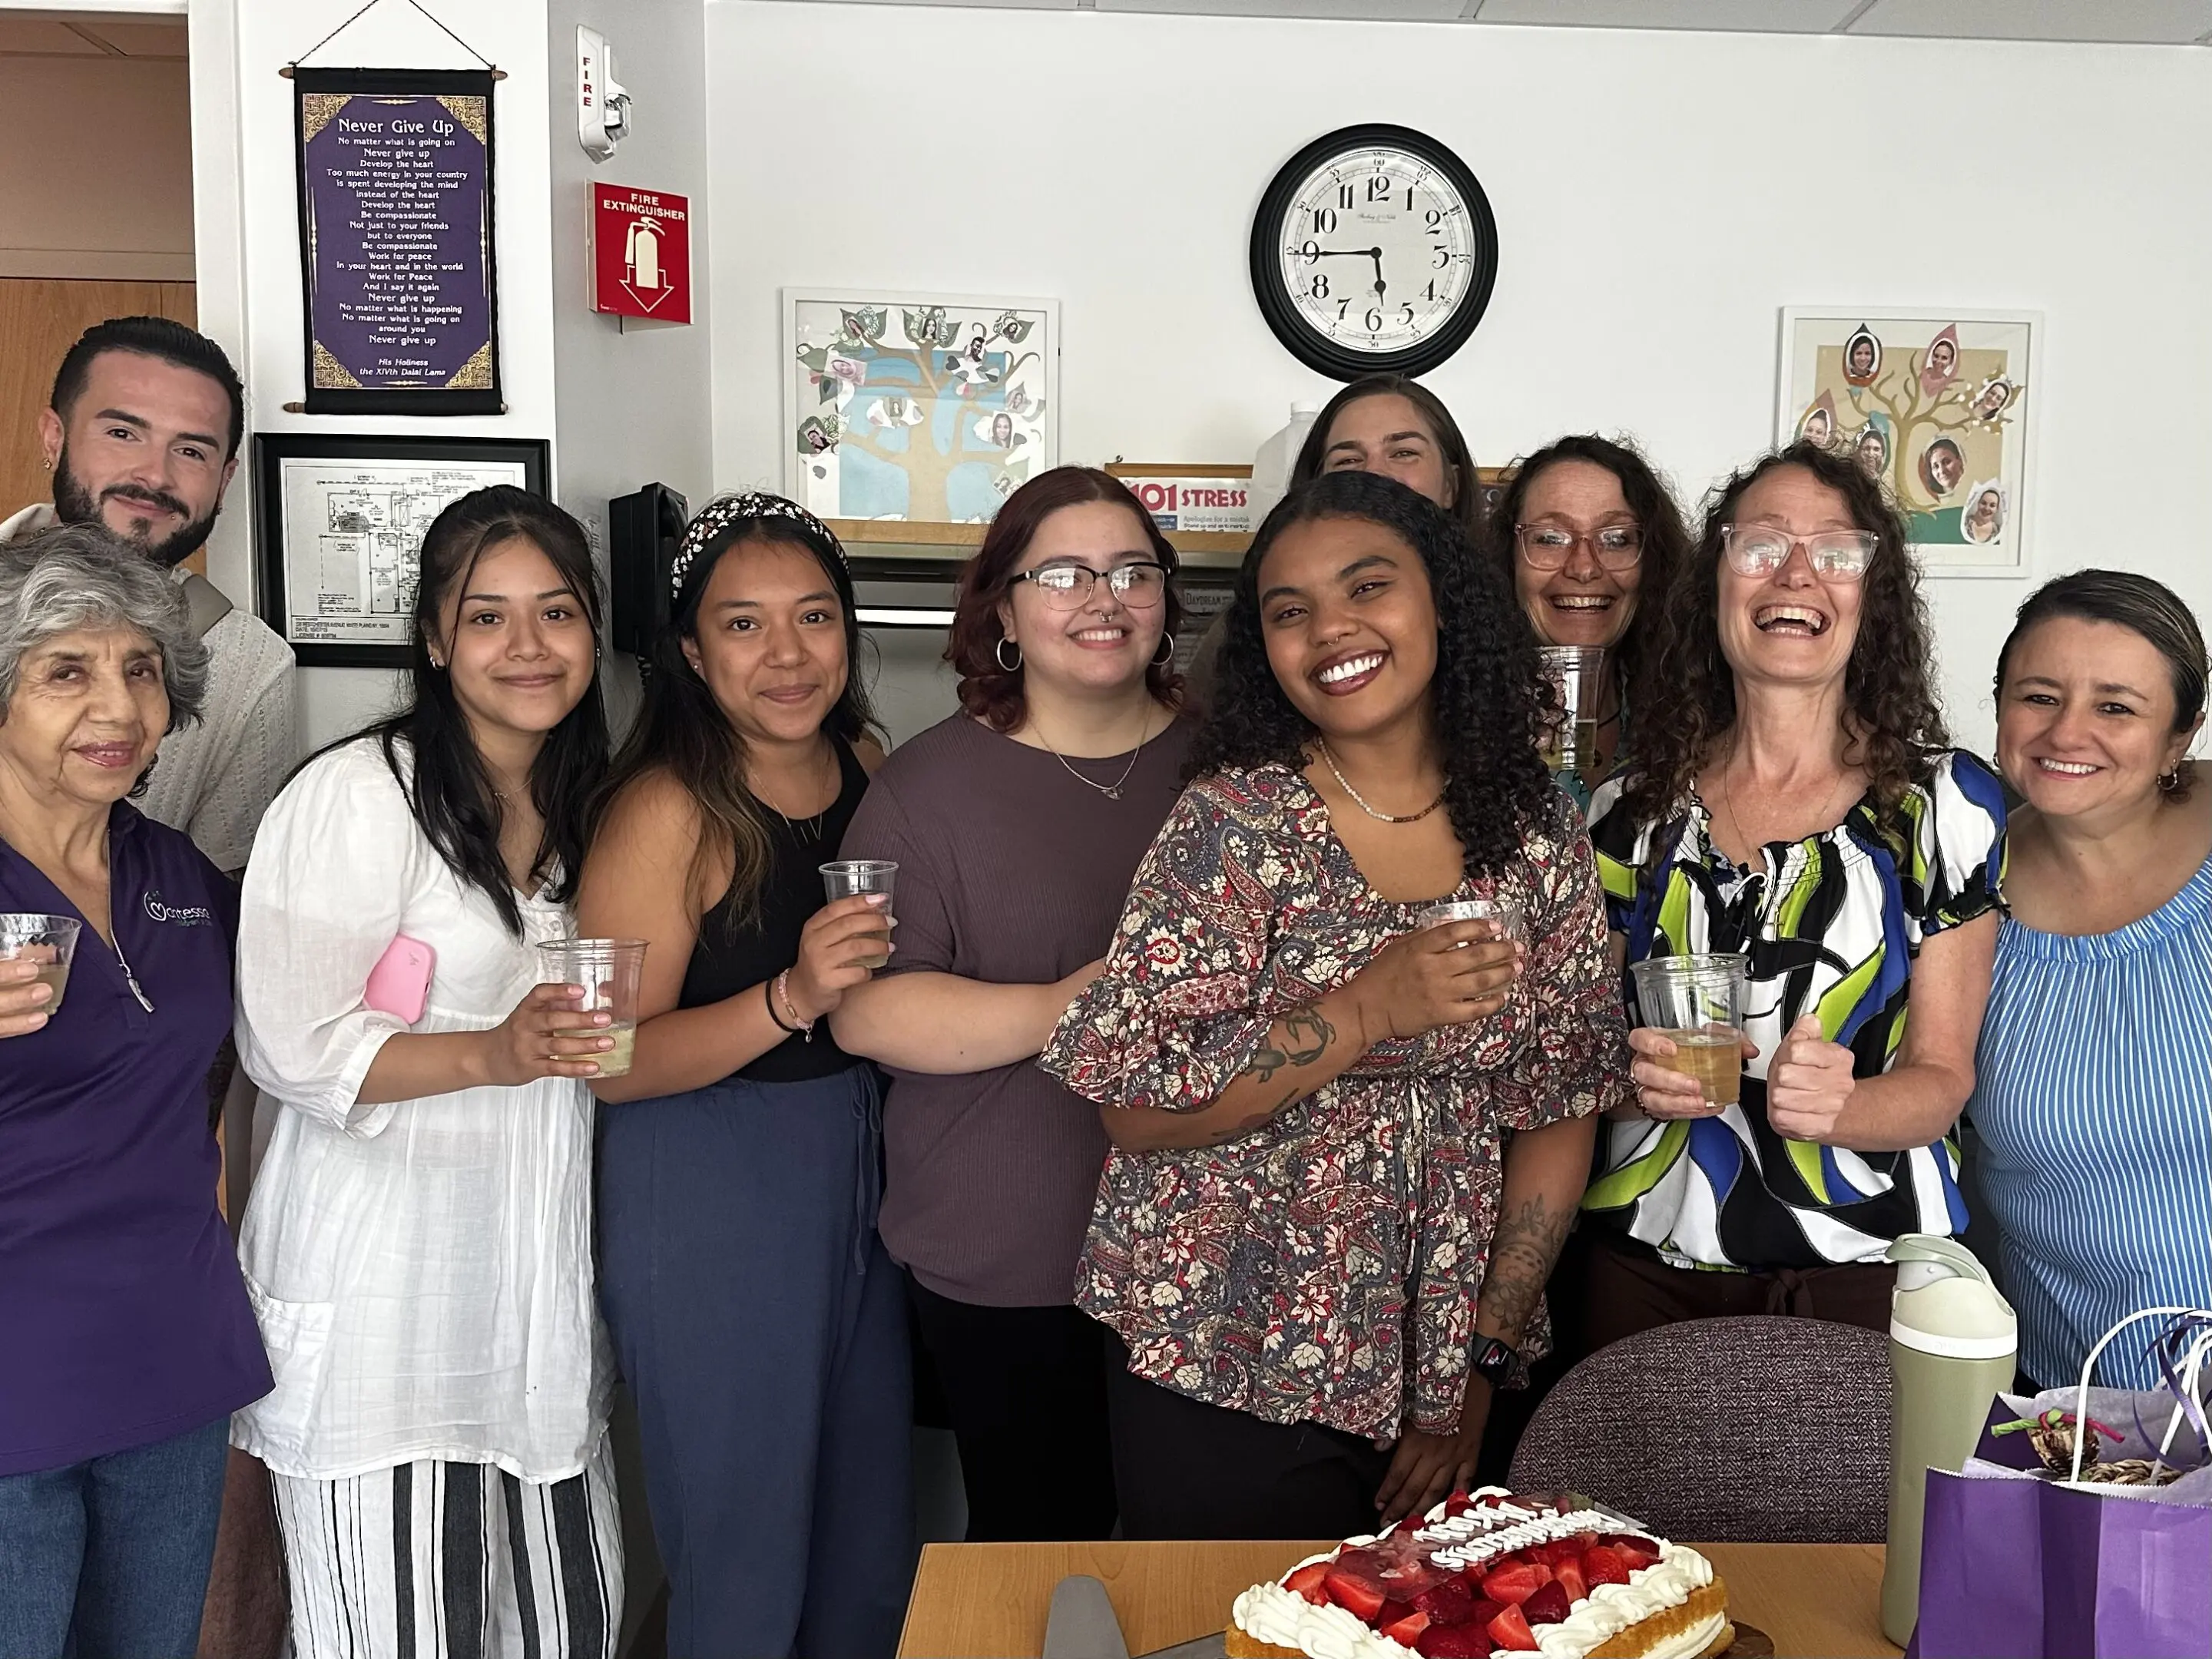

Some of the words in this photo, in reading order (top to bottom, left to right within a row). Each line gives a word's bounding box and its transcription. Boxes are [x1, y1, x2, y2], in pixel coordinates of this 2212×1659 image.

[583, 57, 592, 107] FIRE
[338, 119, 384, 132] Never
[391, 120, 425, 133] Give
[432, 120, 454, 136] Up
[418, 138, 441, 147] going
[363, 148, 392, 157] Never
[395, 149, 414, 159] give
[359, 160, 393, 169] Develop
[436, 171, 468, 180] country
[374, 180, 418, 190] developing
[1367, 176, 1390, 202] 12
[361, 200, 395, 210] Develop
[631, 193, 659, 206] FIRE
[1339, 184, 1353, 209] 11
[1406, 186, 1412, 211] 1
[603, 199, 685, 221] EXTINGUISHER
[366, 221, 384, 230] just
[1314, 208, 1336, 233] 10
[1426, 210, 1441, 235] 2
[376, 243, 438, 251] compassionate
[1303, 240, 1320, 265] 9
[1432, 245, 1447, 269] 3
[417, 283, 440, 292] again
[1312, 274, 1329, 299] 8
[1419, 277, 1438, 301] 4
[368, 293, 396, 302] Never
[399, 294, 419, 304] give
[421, 306, 462, 314] happening
[1337, 297, 1353, 320] 7
[1397, 301, 1414, 325] 5
[424, 316, 447, 324] going
[1365, 307, 1382, 331] 6
[369, 335, 397, 343] Never
[400, 336, 420, 346] give
[1181, 489, 1247, 508] STRESS
